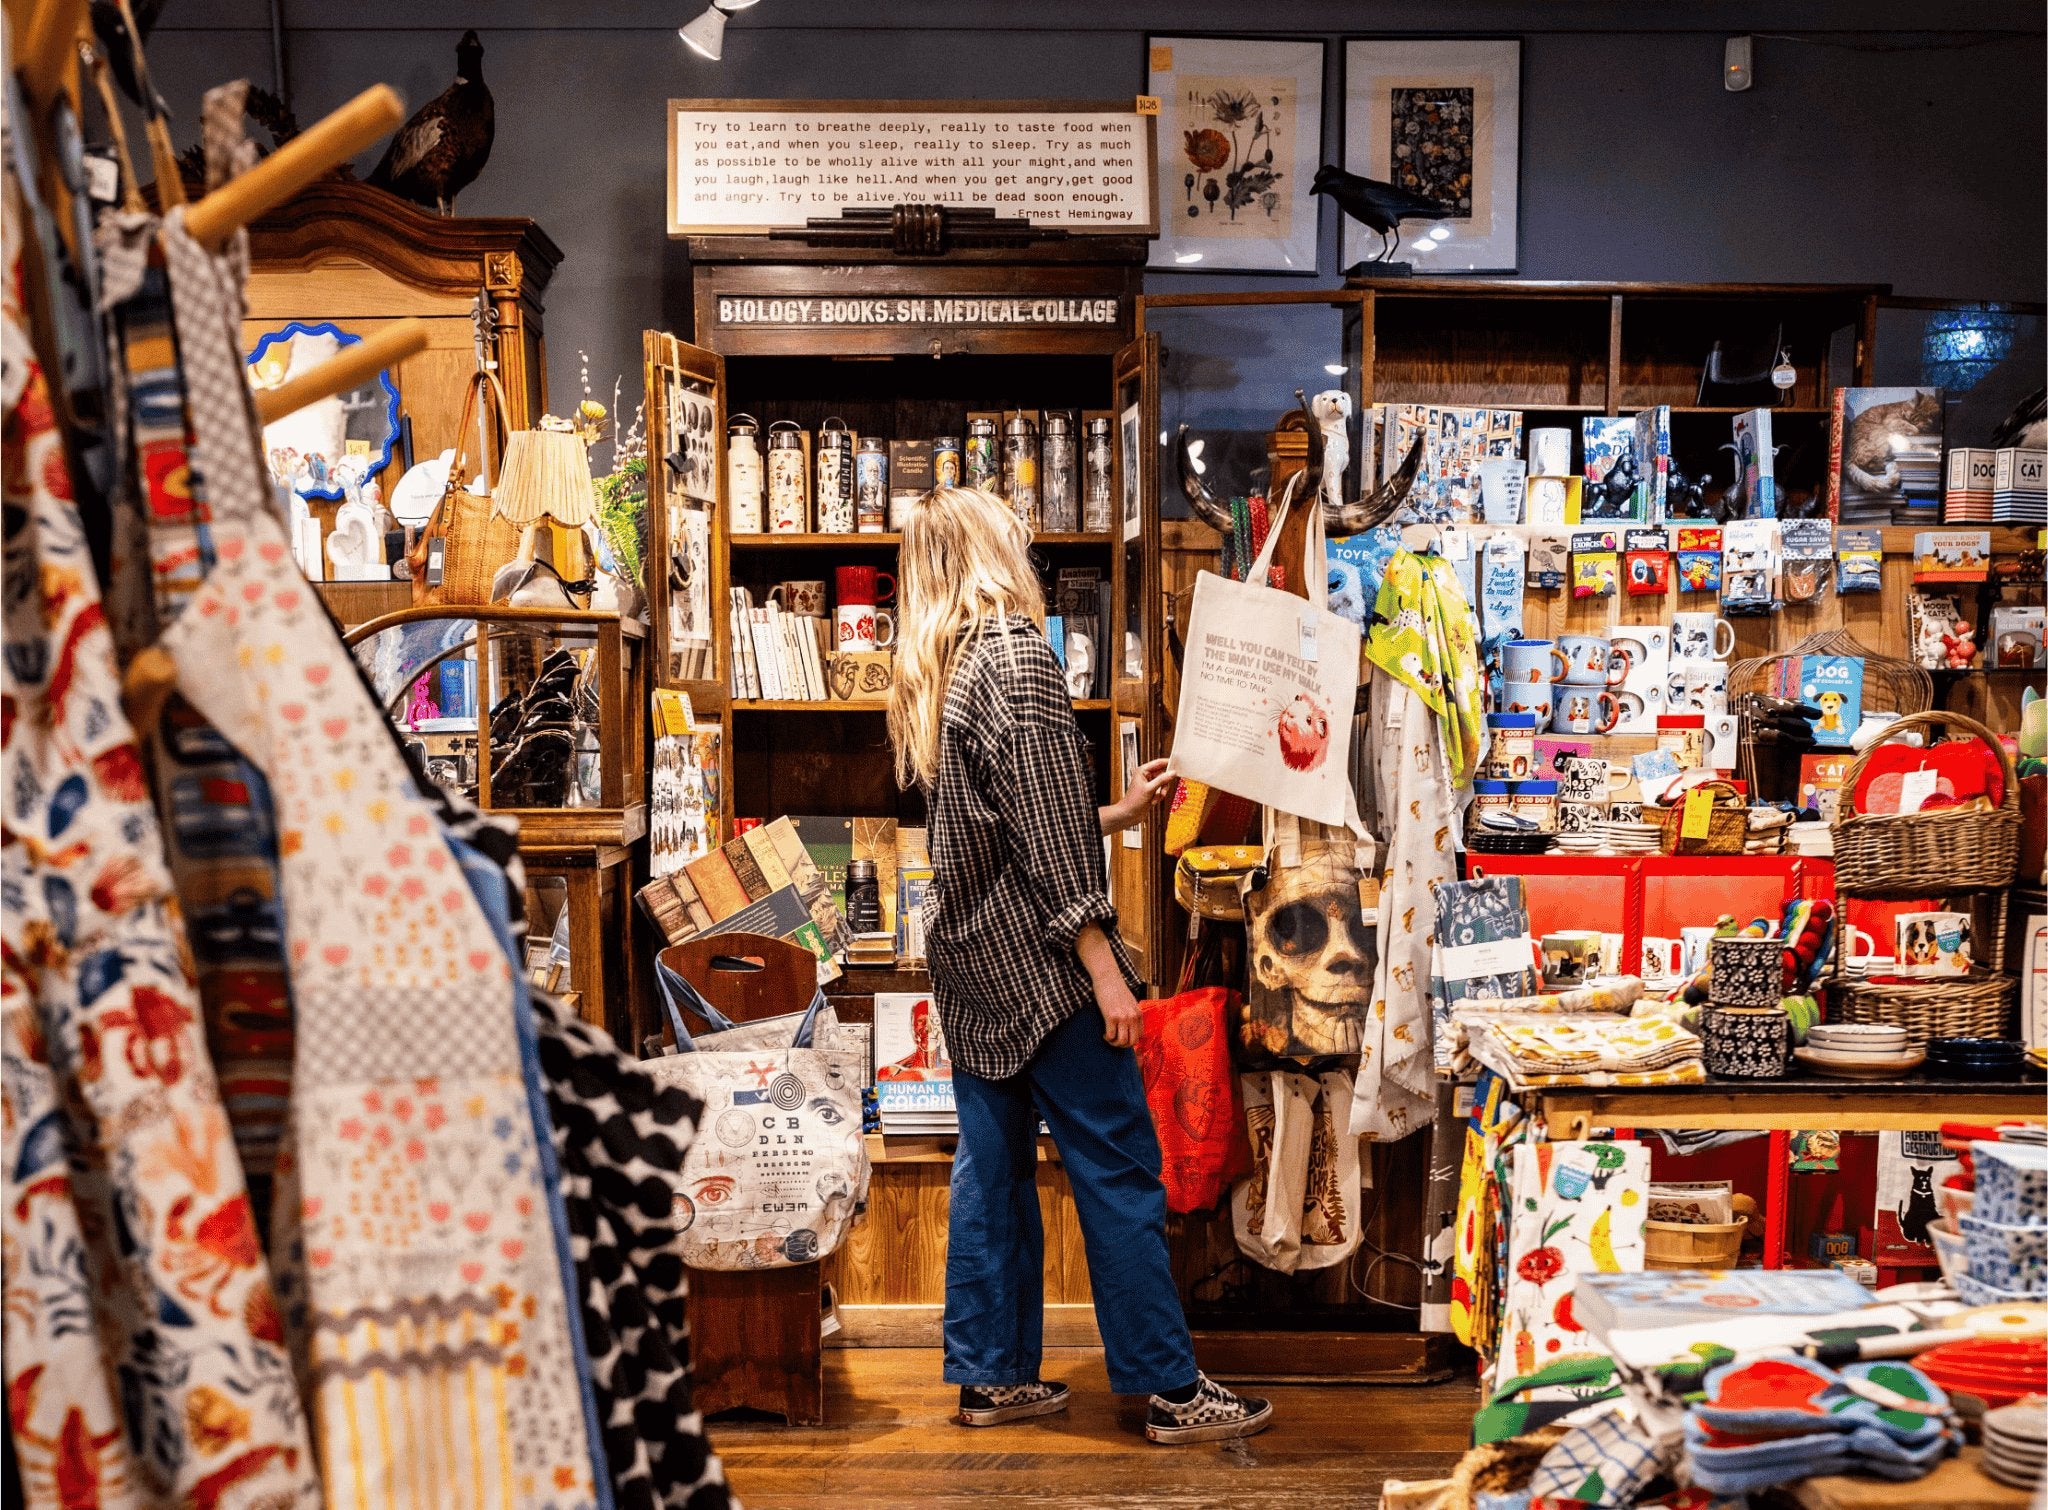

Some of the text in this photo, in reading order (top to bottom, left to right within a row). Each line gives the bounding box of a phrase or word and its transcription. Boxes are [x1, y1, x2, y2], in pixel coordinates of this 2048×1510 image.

[695, 122, 1131, 134] Try to learn to breathe deeply, really to taste food when
[695, 141, 717, 151] you
[788, 139, 819, 149] when
[828, 141, 850, 151] you
[859, 140, 903, 151] sleep,
[914, 140, 960, 151] really
[968, 140, 983, 149] to
[992, 140, 1035, 151] sleep.
[1046, 140, 1069, 152] Try
[1100, 140, 1131, 149] much
[695, 158, 709, 166] as
[717, 157, 776, 168] possible
[784, 157, 798, 166] to
[806, 157, 820, 166] be
[828, 157, 872, 168] wholly
[881, 156, 917, 166] alive
[925, 157, 955, 166] with
[963, 157, 984, 166] all
[992, 159, 1022, 169] your
[1103, 157, 1132, 167] when
[695, 176, 716, 186] you
[819, 174, 848, 184] like
[925, 174, 956, 184] when
[965, 176, 987, 186] you
[995, 175, 1017, 186] get
[1103, 175, 1132, 186] good
[695, 192, 717, 201] and
[726, 193, 769, 203] angry.
[780, 192, 801, 203] Try
[811, 192, 825, 201] to
[834, 192, 848, 201] be
[934, 192, 964, 202] will
[973, 192, 987, 201] be
[995, 192, 1025, 201] dead
[1073, 192, 1123, 204] enough.
[1012, 209, 1133, 220] -Ernest Hemingway
[1973, 464, 1995, 477] DOG
[2021, 464, 2043, 477] CAT
[1062, 569, 1099, 579] Anatomy
[1070, 580, 1095, 588] Stamp
[1206, 633, 1318, 678] WELL YOU CAN TELL BY
[1202, 661, 1214, 671] I'M
[1225, 666, 1257, 680] GUINEA
[1204, 647, 1226, 661] THE
[1228, 653, 1254, 667] WAY
[1262, 661, 1281, 676] USE
[1282, 667, 1296, 682] MY
[1299, 674, 1321, 695] WALK
[1816, 664, 1849, 679] DOG
[1200, 671, 1267, 694] NO TIME TO TALK
[1816, 764, 1846, 776] CAT
[888, 1084, 934, 1094] HUMAN
[883, 1095, 954, 1106] COLORIN
[762, 1117, 800, 1129] C B
[759, 1135, 804, 1144] D L N
[1905, 1130, 1939, 1140] AGENT
